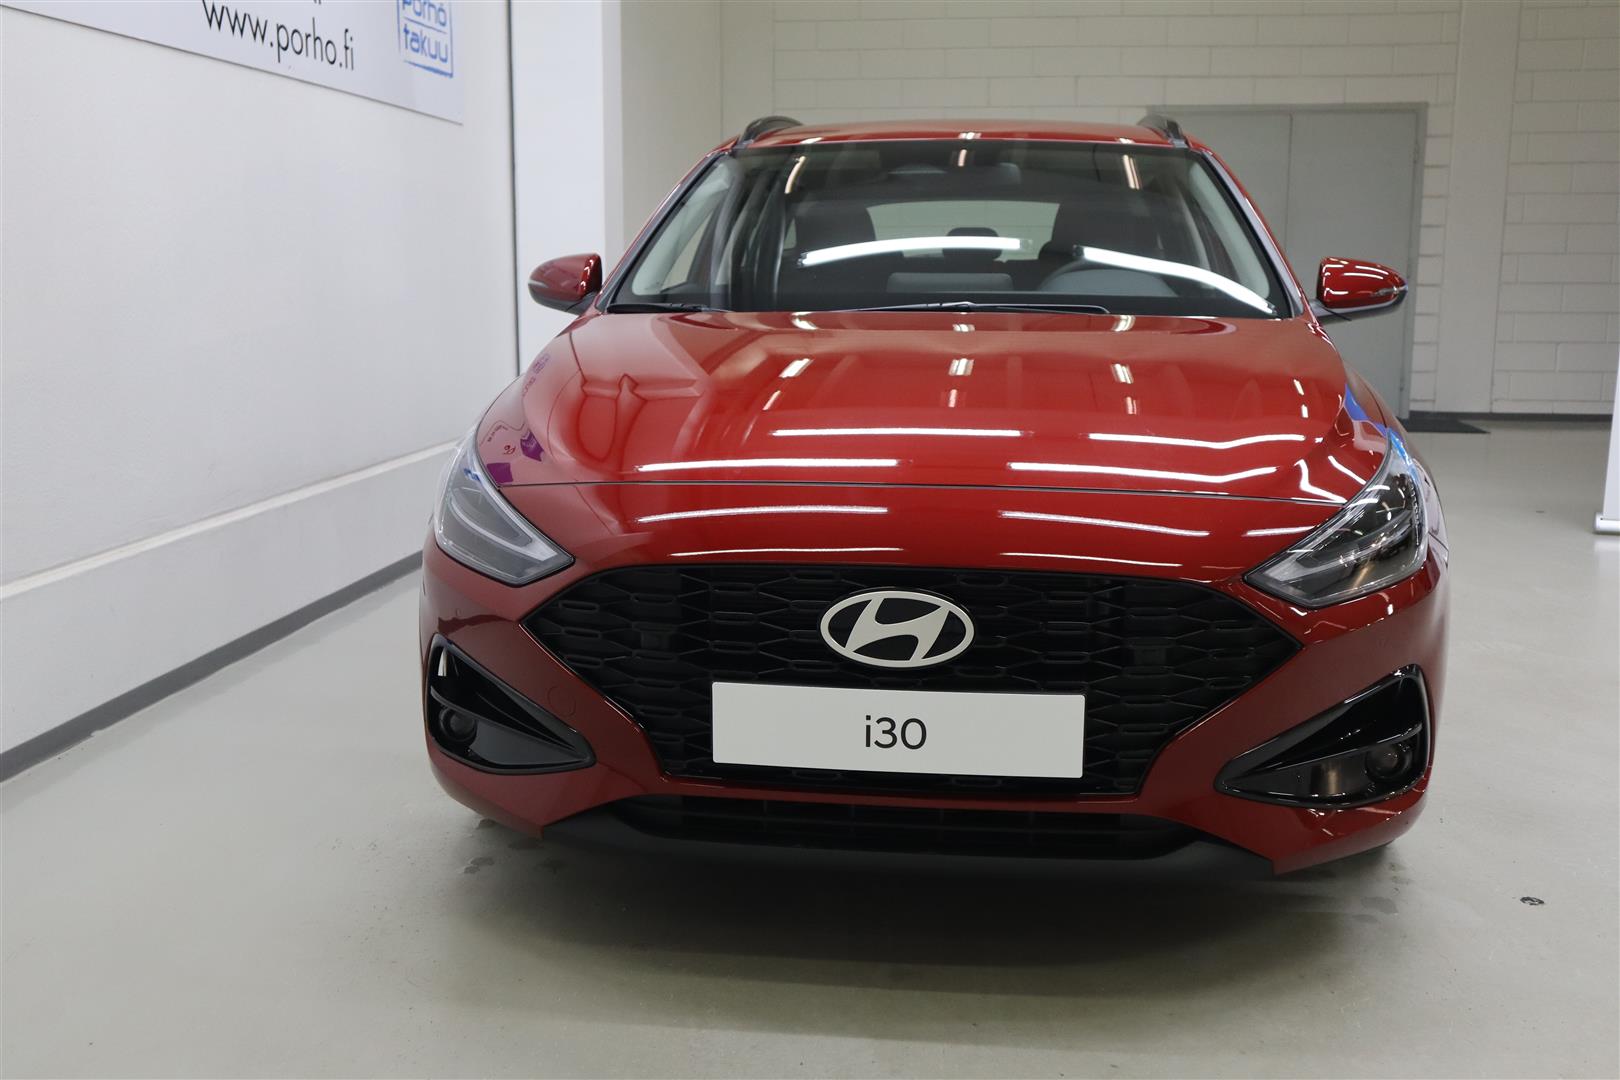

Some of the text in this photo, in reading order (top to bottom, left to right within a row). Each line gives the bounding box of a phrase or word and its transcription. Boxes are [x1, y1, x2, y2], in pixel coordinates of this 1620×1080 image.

[202, 0, 354, 71] www.porho.fi
[403, 23, 448, 63] takuu
[865, 715, 927, 750] i30
